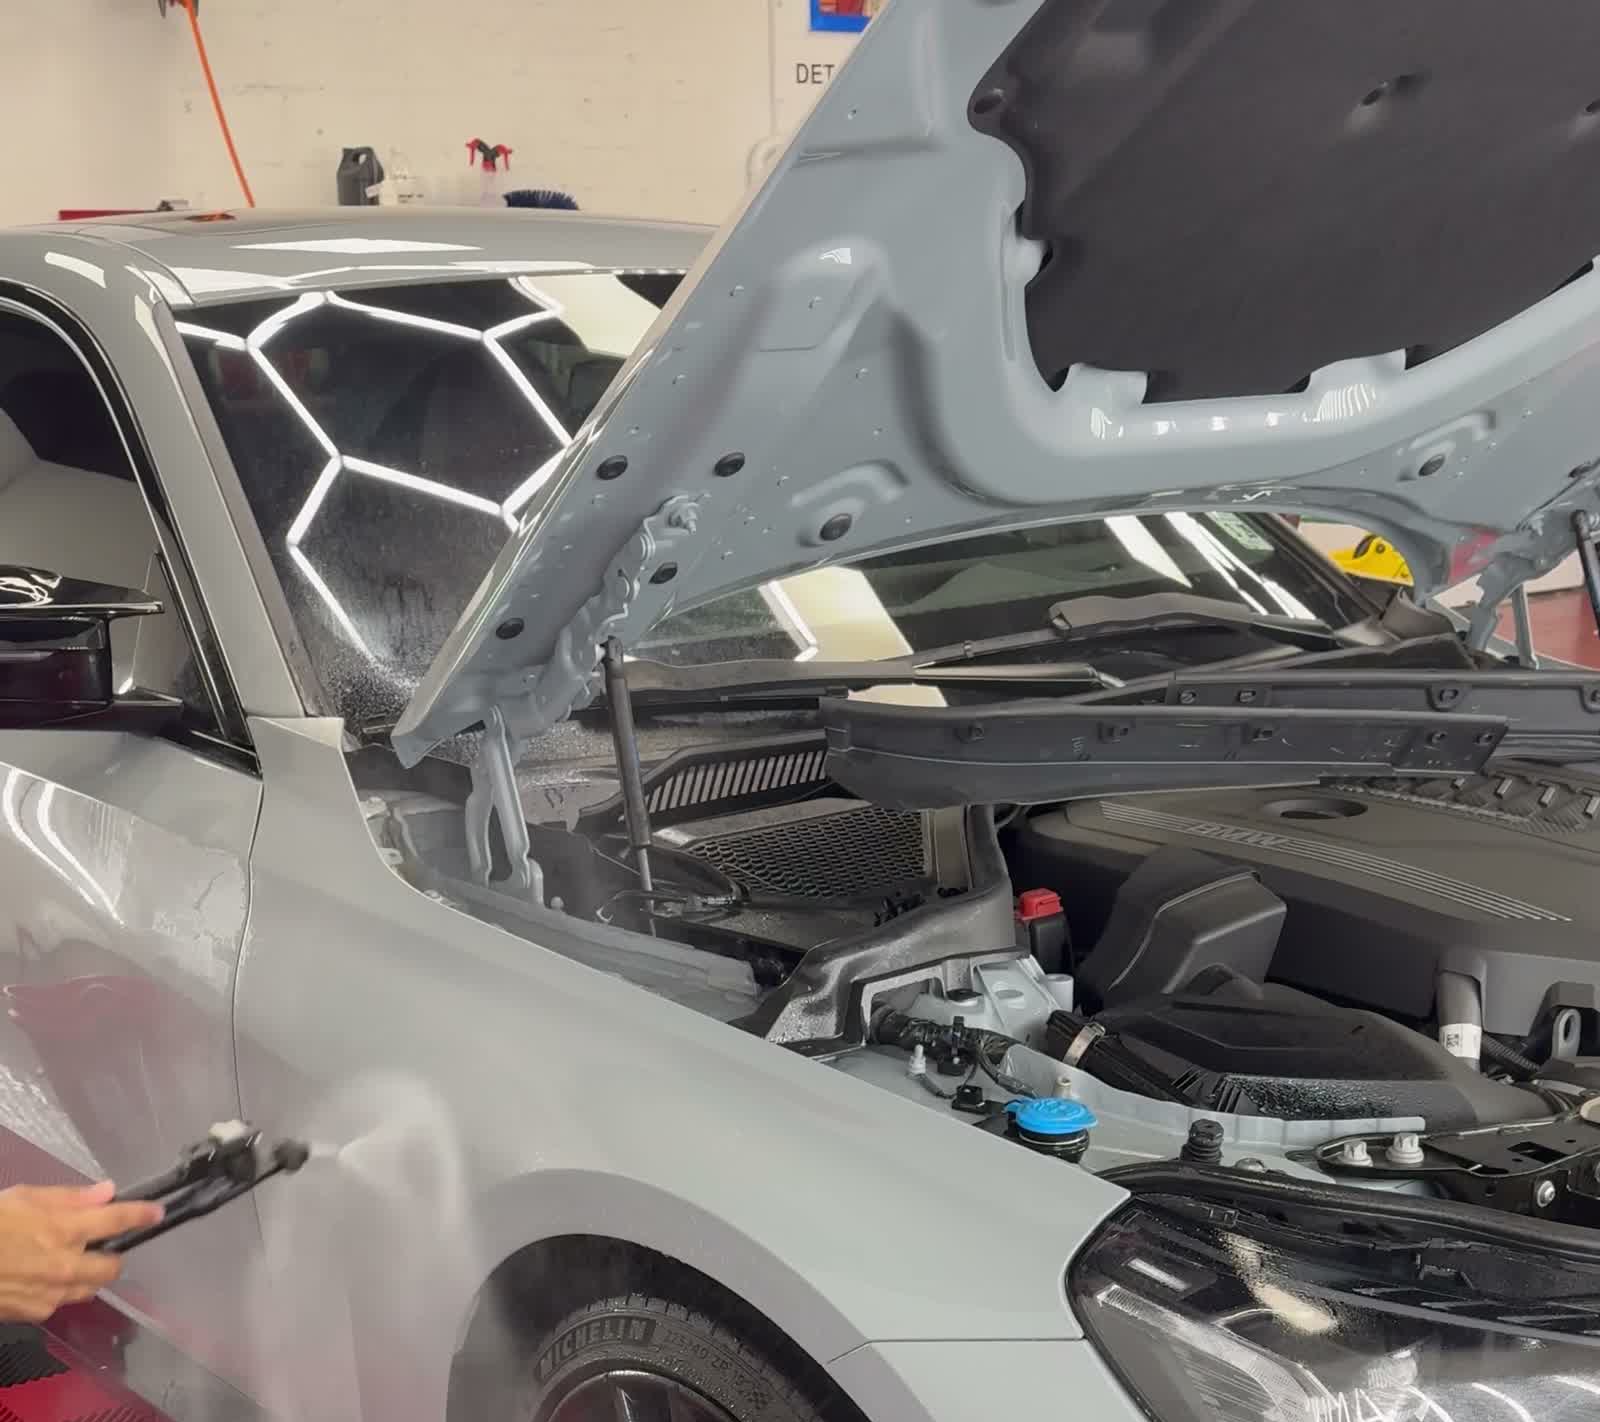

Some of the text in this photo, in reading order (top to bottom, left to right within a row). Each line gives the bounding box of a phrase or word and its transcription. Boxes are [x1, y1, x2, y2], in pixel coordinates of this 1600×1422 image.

[796, 63, 835, 84] DET
[1186, 821, 1287, 848] BMW
[540, 1317, 648, 1379] MICHELIN
